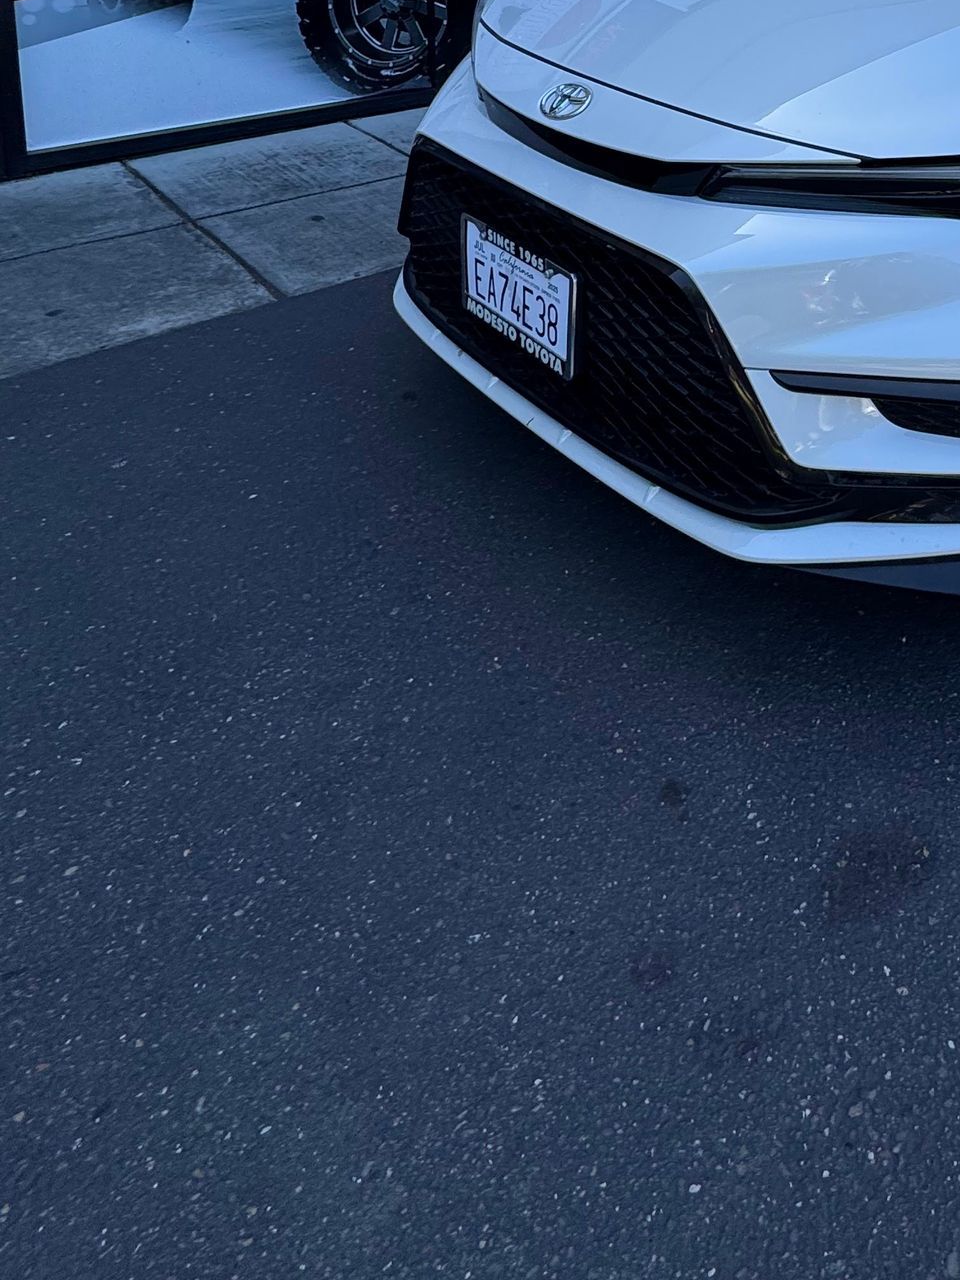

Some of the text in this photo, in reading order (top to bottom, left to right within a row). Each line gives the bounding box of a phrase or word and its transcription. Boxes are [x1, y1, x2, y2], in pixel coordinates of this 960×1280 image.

[487, 228, 515, 254] SINCE
[519, 246, 545, 272] 1965
[498, 250, 534, 280] California
[466, 296, 517, 342] MODESTO
[474, 257, 559, 347] EA74E38
[519, 332, 564, 377] TOYOTA
